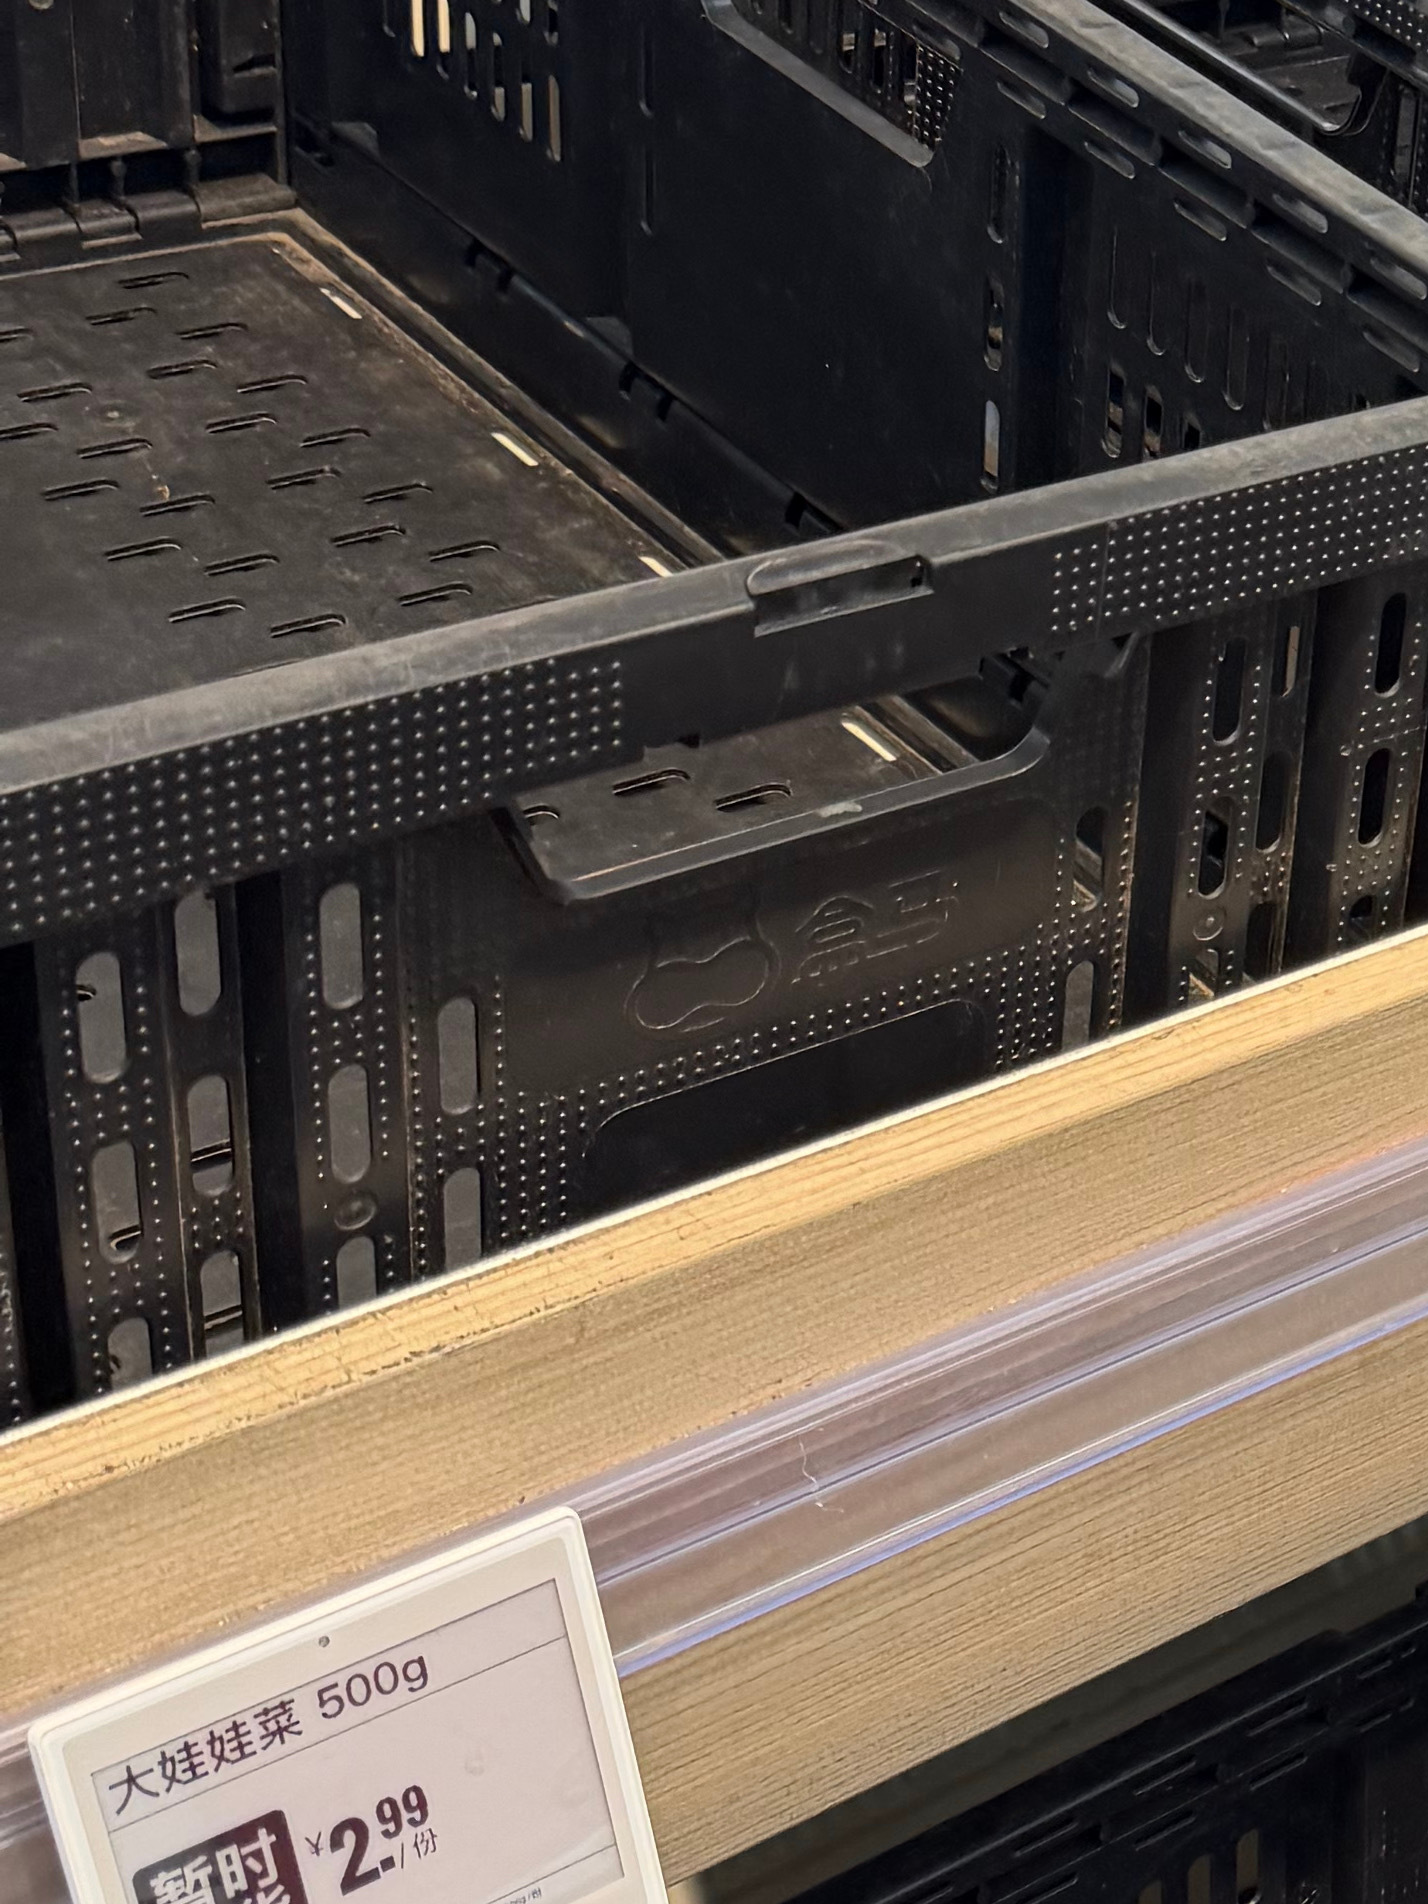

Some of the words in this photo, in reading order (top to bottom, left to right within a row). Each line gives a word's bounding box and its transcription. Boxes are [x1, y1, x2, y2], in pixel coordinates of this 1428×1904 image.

[109, 1698, 304, 1816] 大娃娃菜
[318, 1655, 430, 1720] 500g
